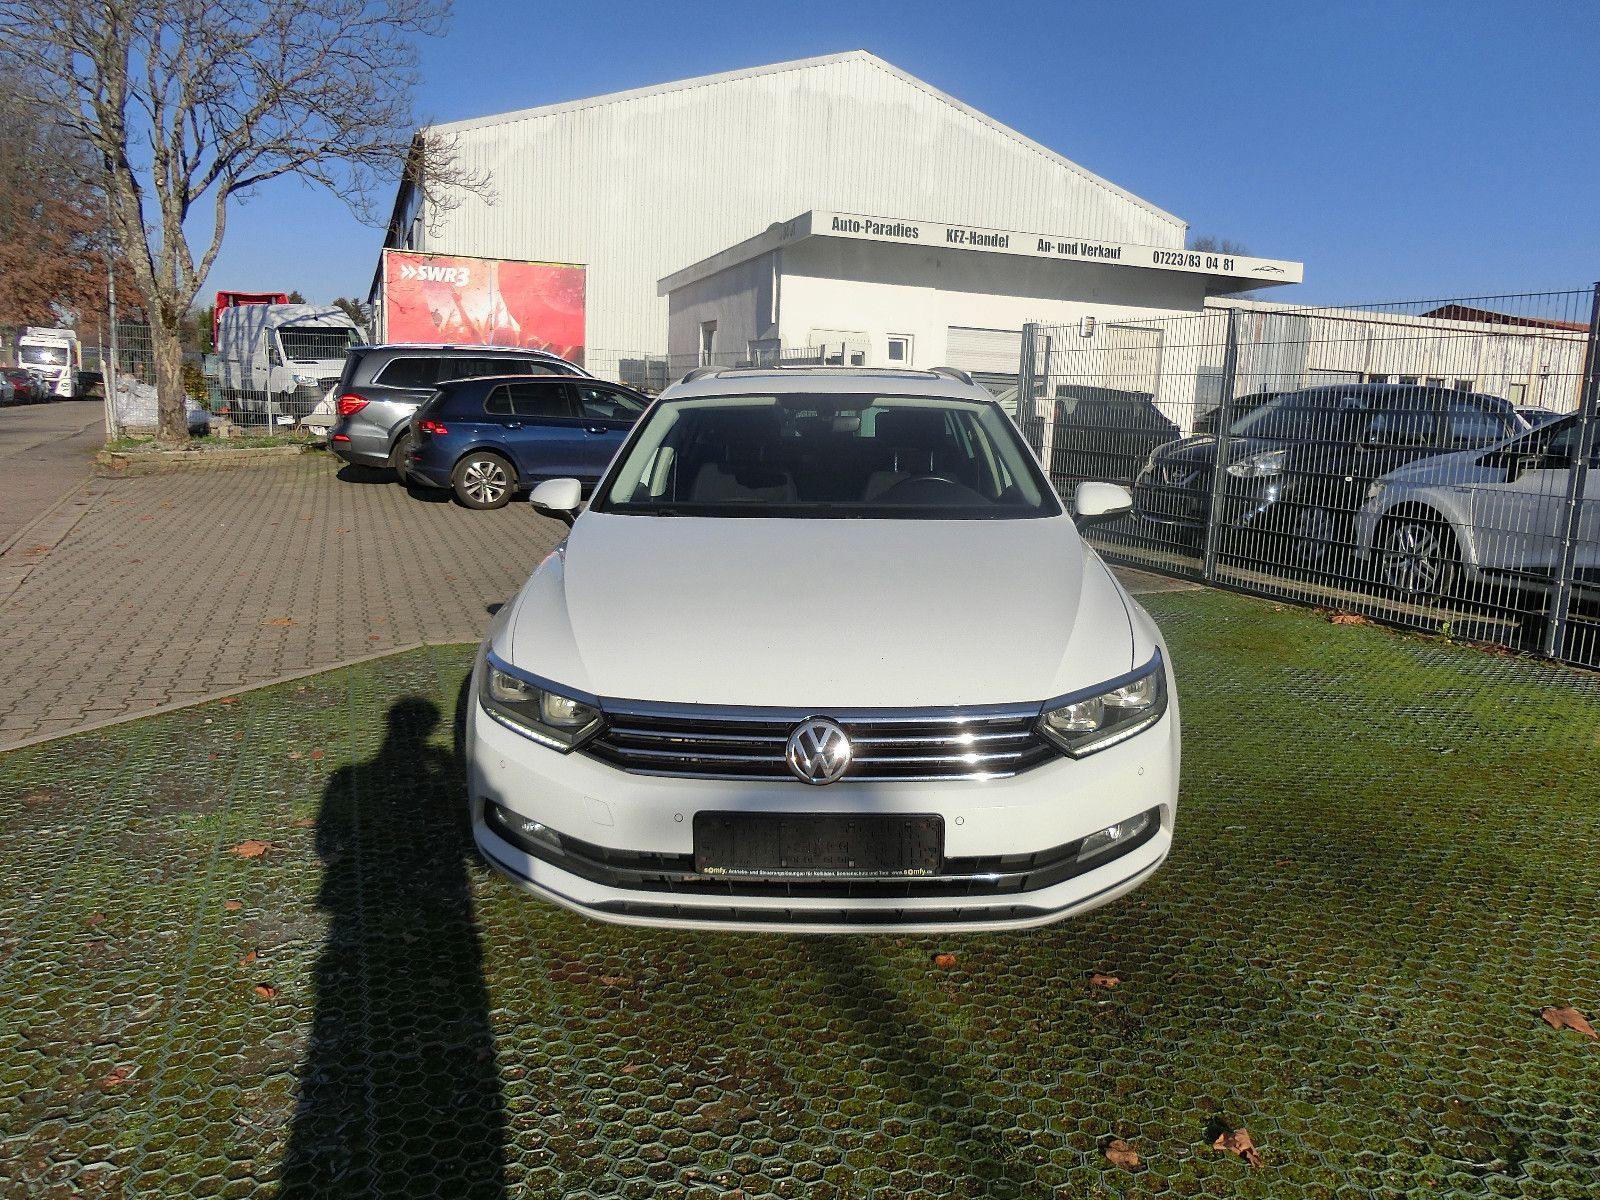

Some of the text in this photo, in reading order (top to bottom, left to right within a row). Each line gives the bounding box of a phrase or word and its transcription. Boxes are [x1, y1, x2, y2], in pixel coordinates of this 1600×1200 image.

[832, 216, 919, 239] Auto-Paradies
[946, 228, 1009, 249] KFZ-Handel
[1037, 238, 1121, 260] An- und Verkauf
[1153, 250, 1235, 272] 07223/83 04 81
[417, 265, 471, 287] SWR3
